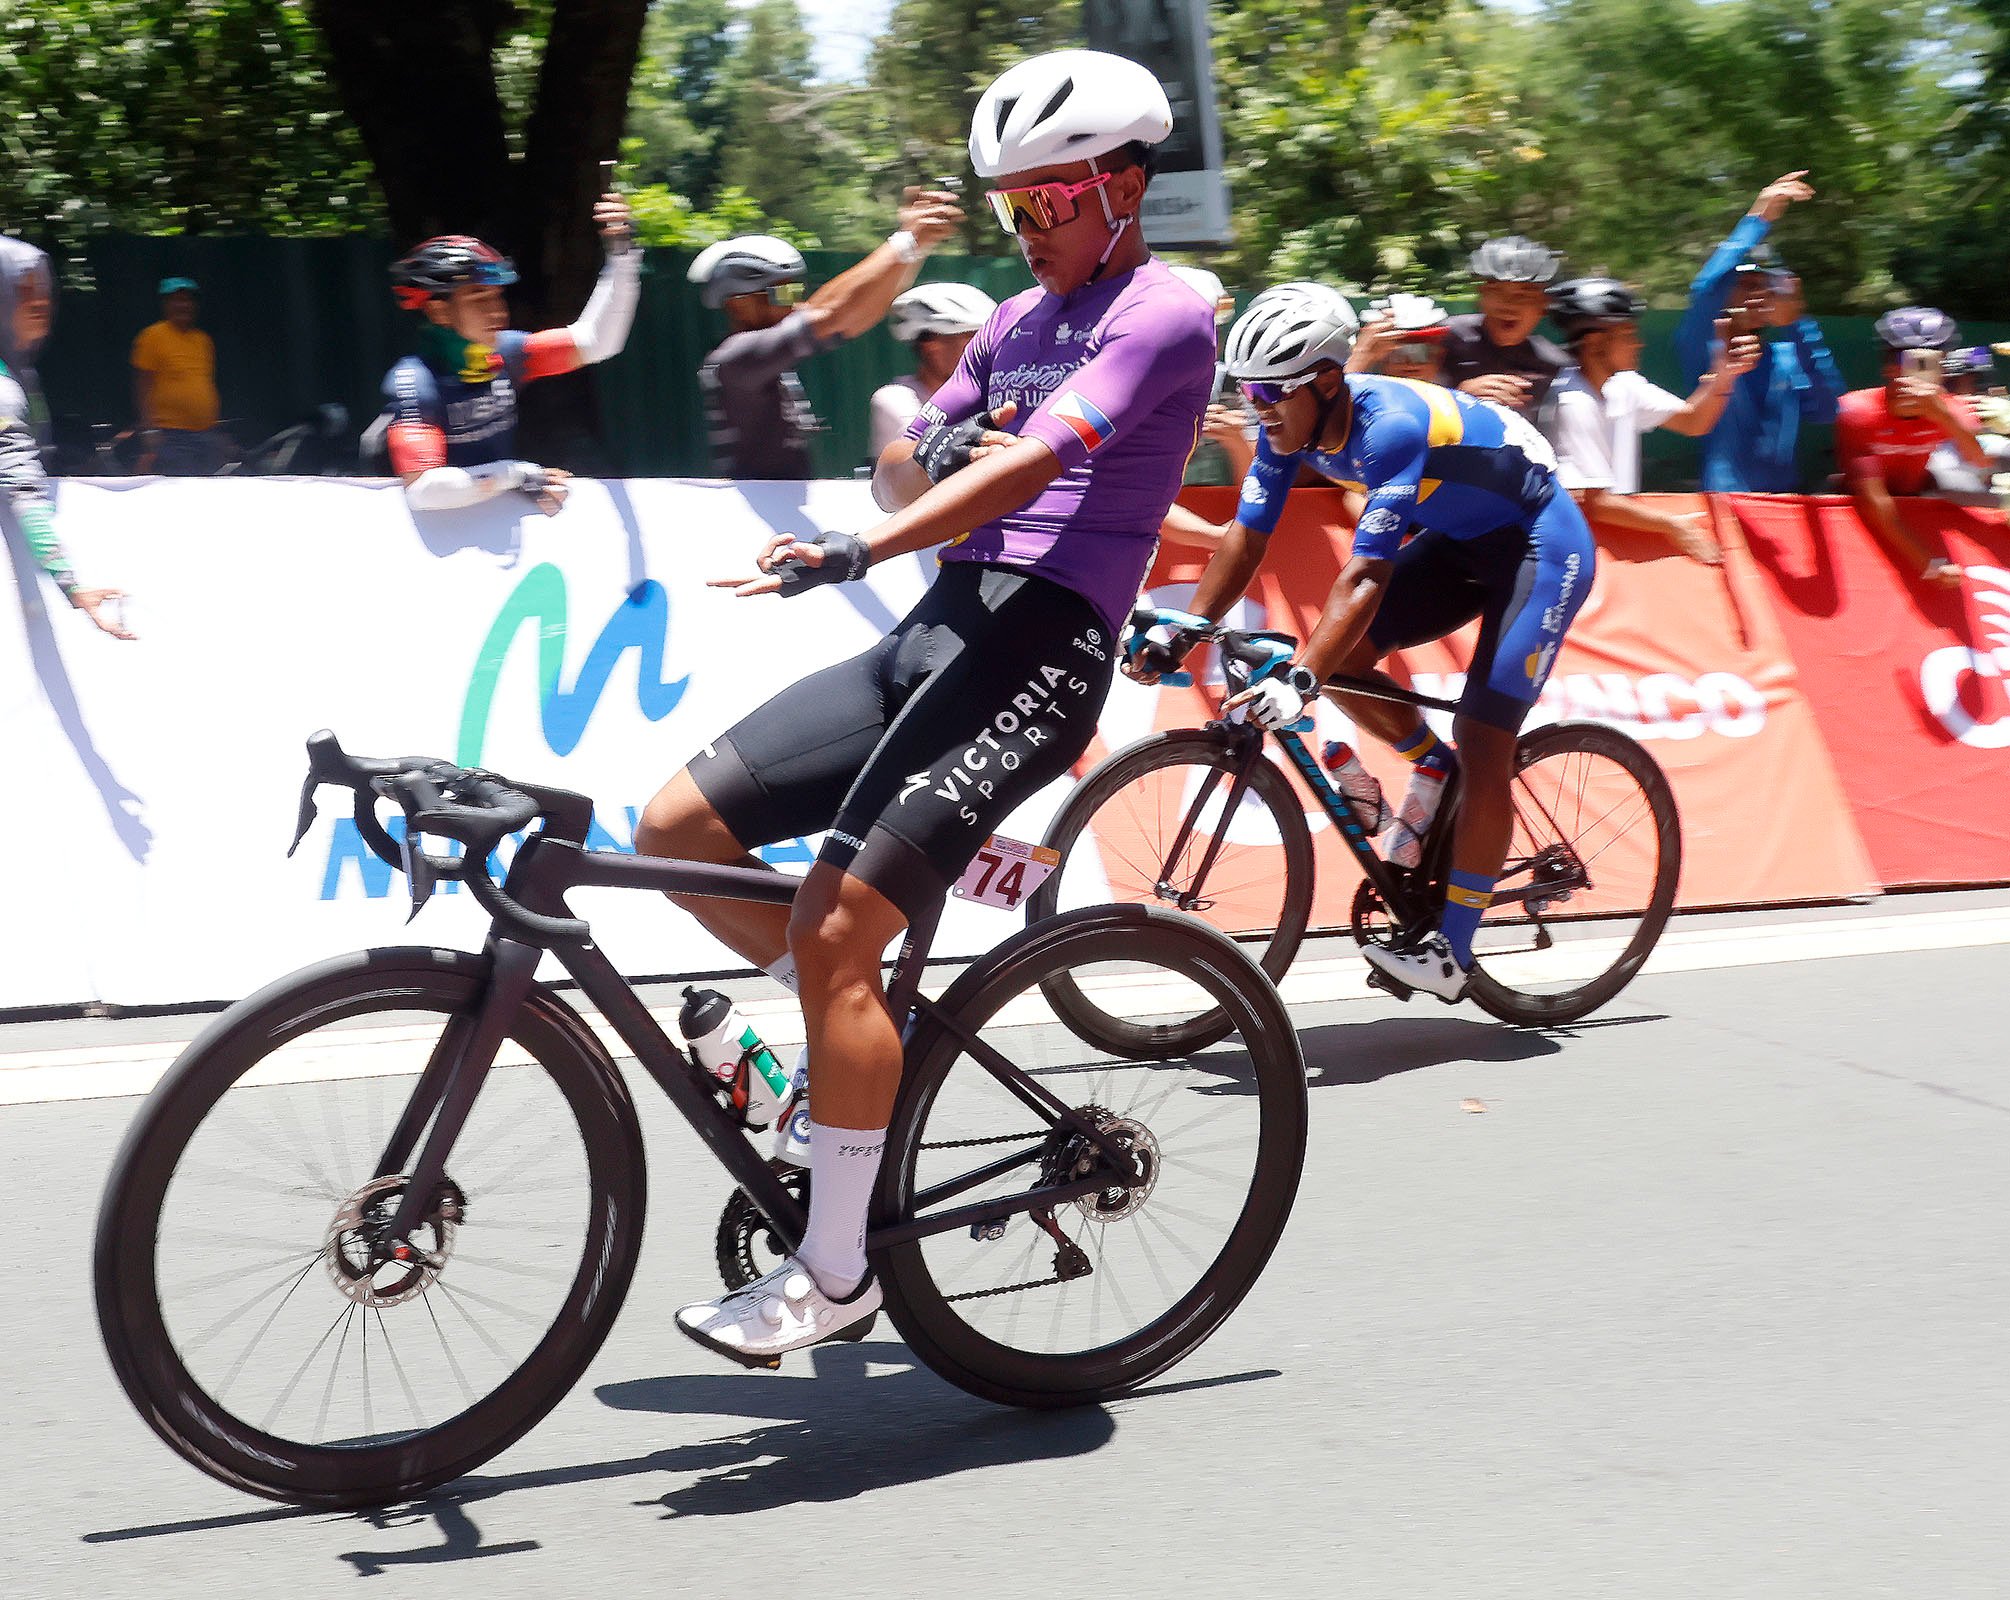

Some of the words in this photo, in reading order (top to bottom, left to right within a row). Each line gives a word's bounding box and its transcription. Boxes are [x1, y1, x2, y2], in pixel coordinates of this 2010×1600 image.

[1073, 637, 1105, 661] PACTO
[934, 665, 1067, 802] VICTORIA
[960, 677, 1088, 825] SPORTS
[973, 852, 1027, 906] 74
